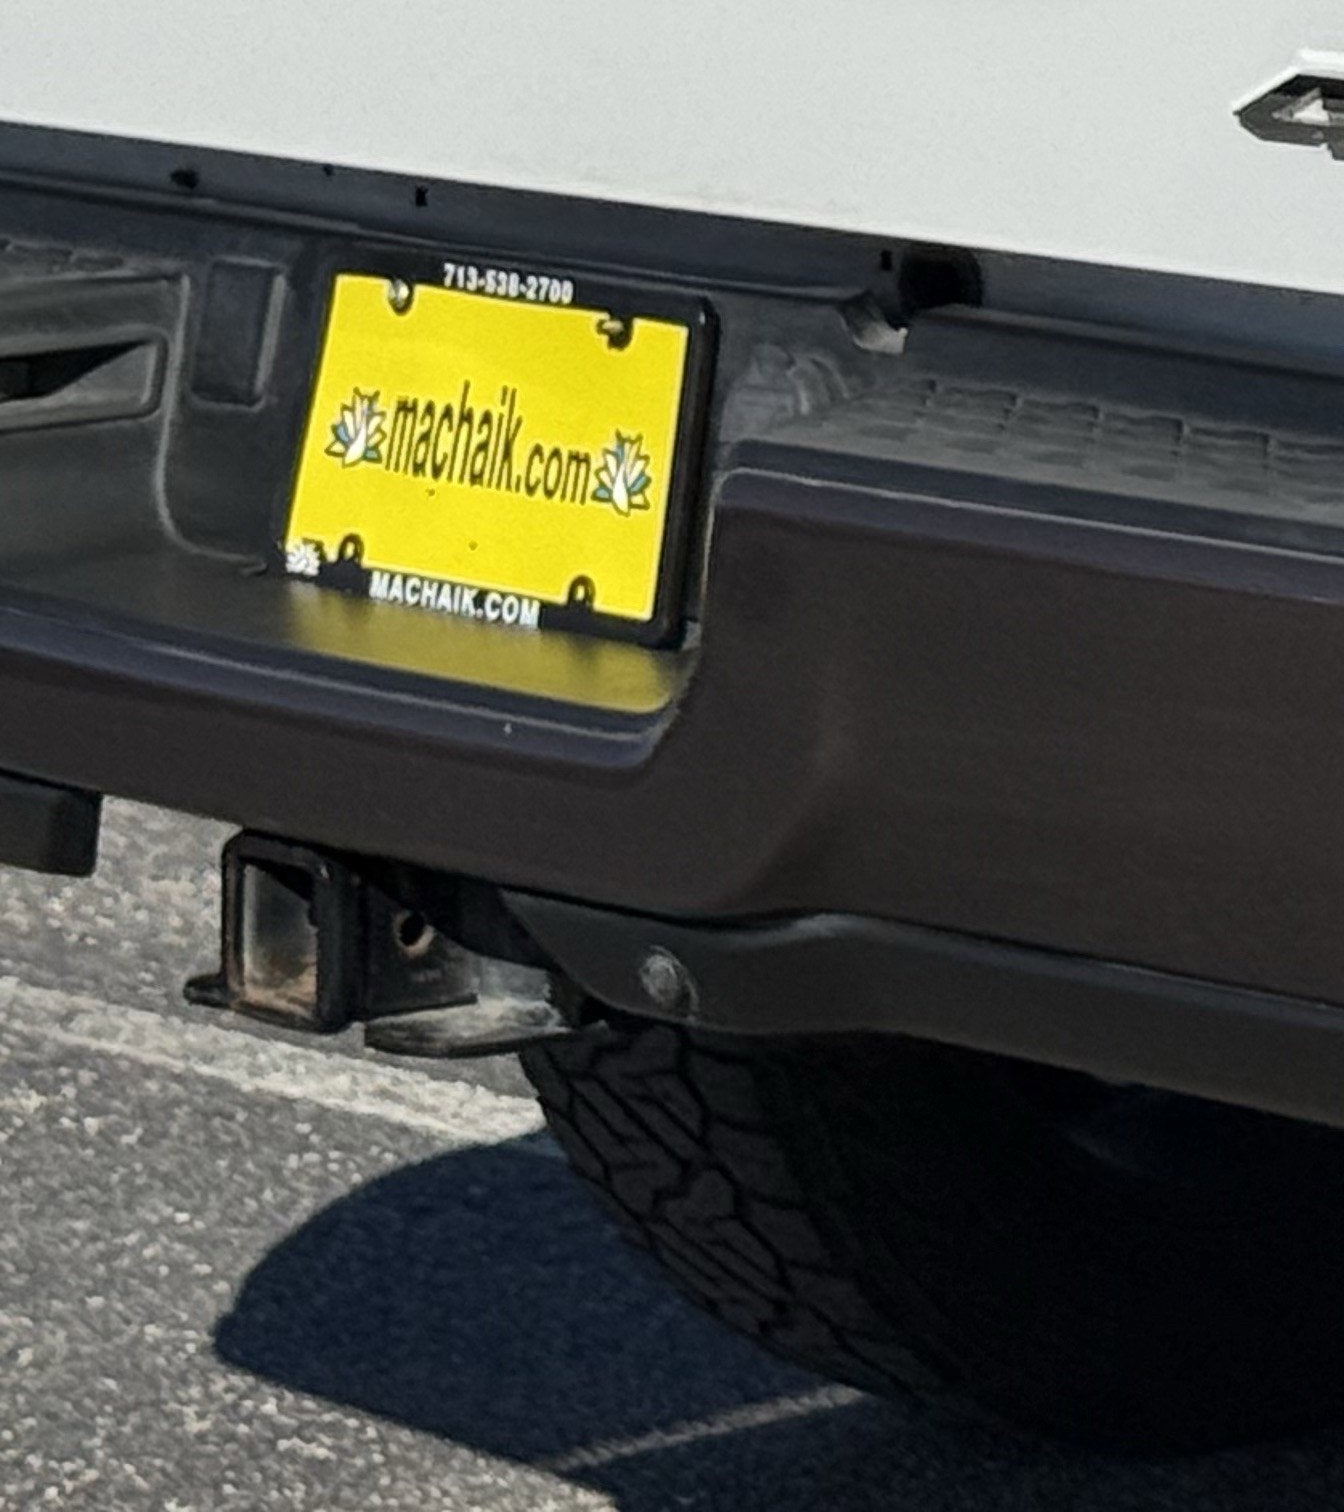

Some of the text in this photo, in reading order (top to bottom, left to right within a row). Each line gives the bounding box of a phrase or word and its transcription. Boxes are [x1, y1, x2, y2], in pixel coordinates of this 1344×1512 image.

[443, 261, 575, 305] 713-538-2700
[385, 380, 593, 506] machaik.com
[368, 570, 541, 628] MACHAIK.COM
